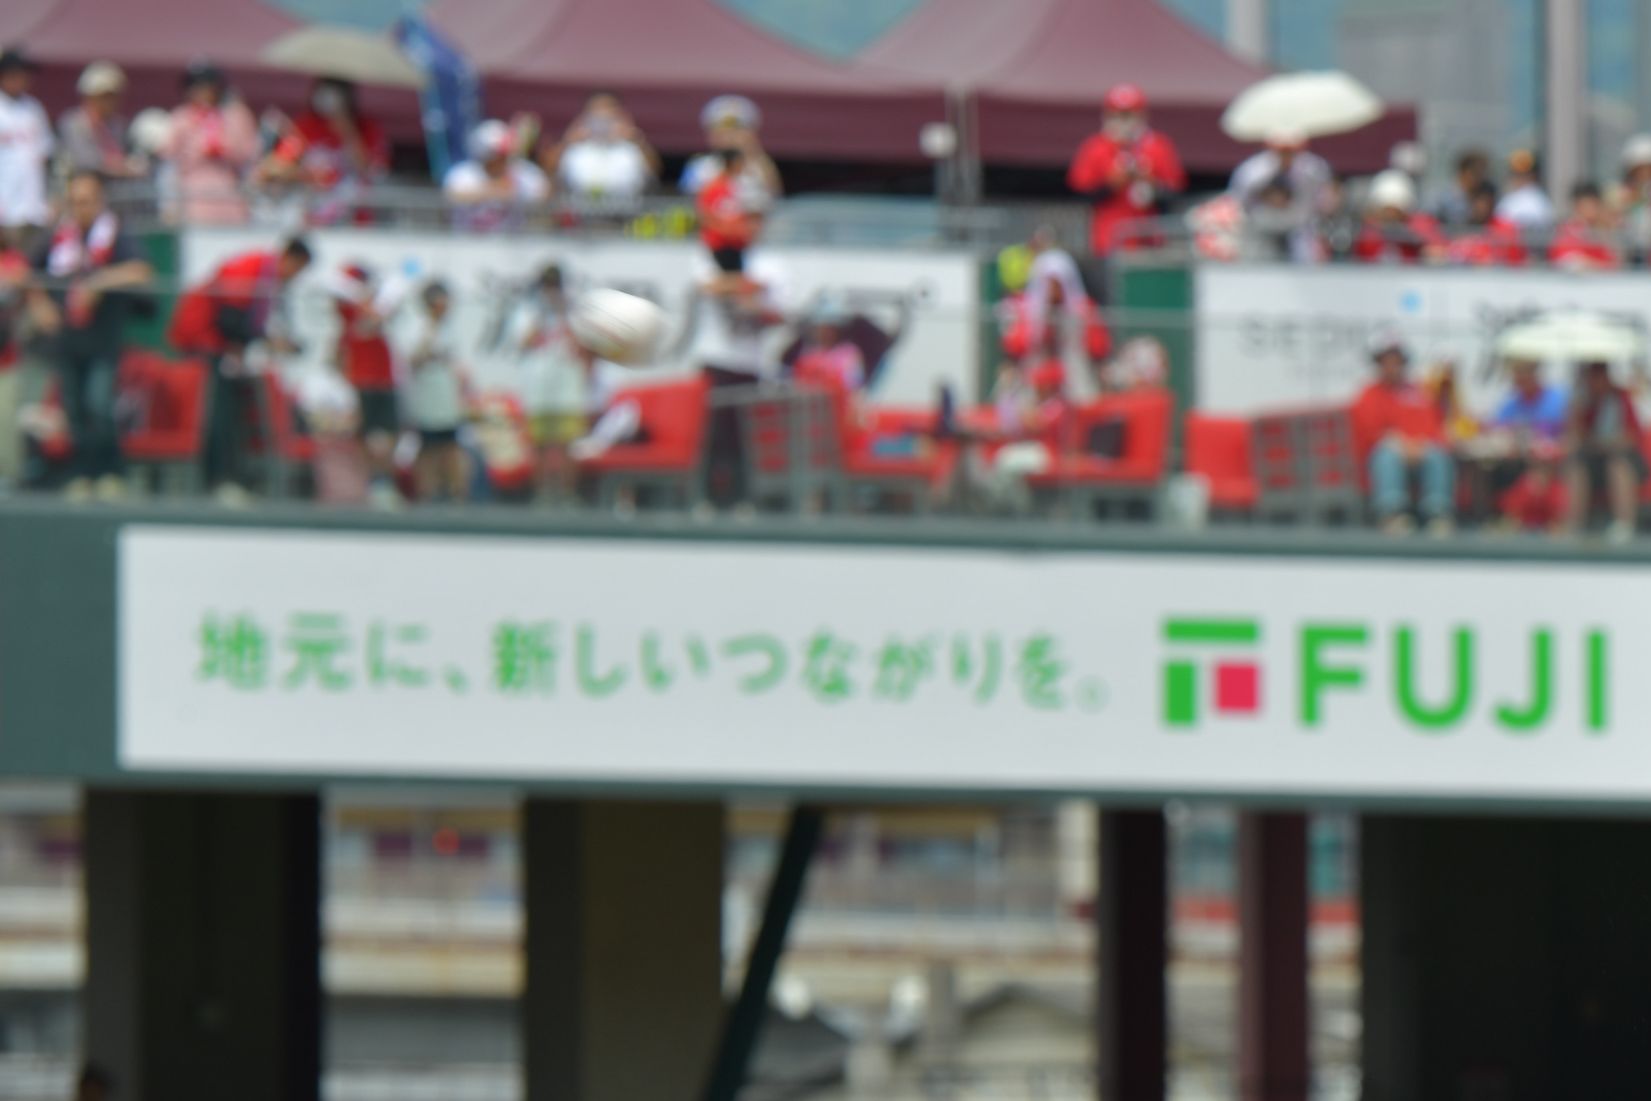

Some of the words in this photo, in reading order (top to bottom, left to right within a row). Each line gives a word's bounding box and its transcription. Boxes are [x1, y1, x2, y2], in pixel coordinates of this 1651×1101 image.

[195, 610, 1106, 709] 地元に、新しいつながりを。
[1297, 621, 1612, 733] FUJI
